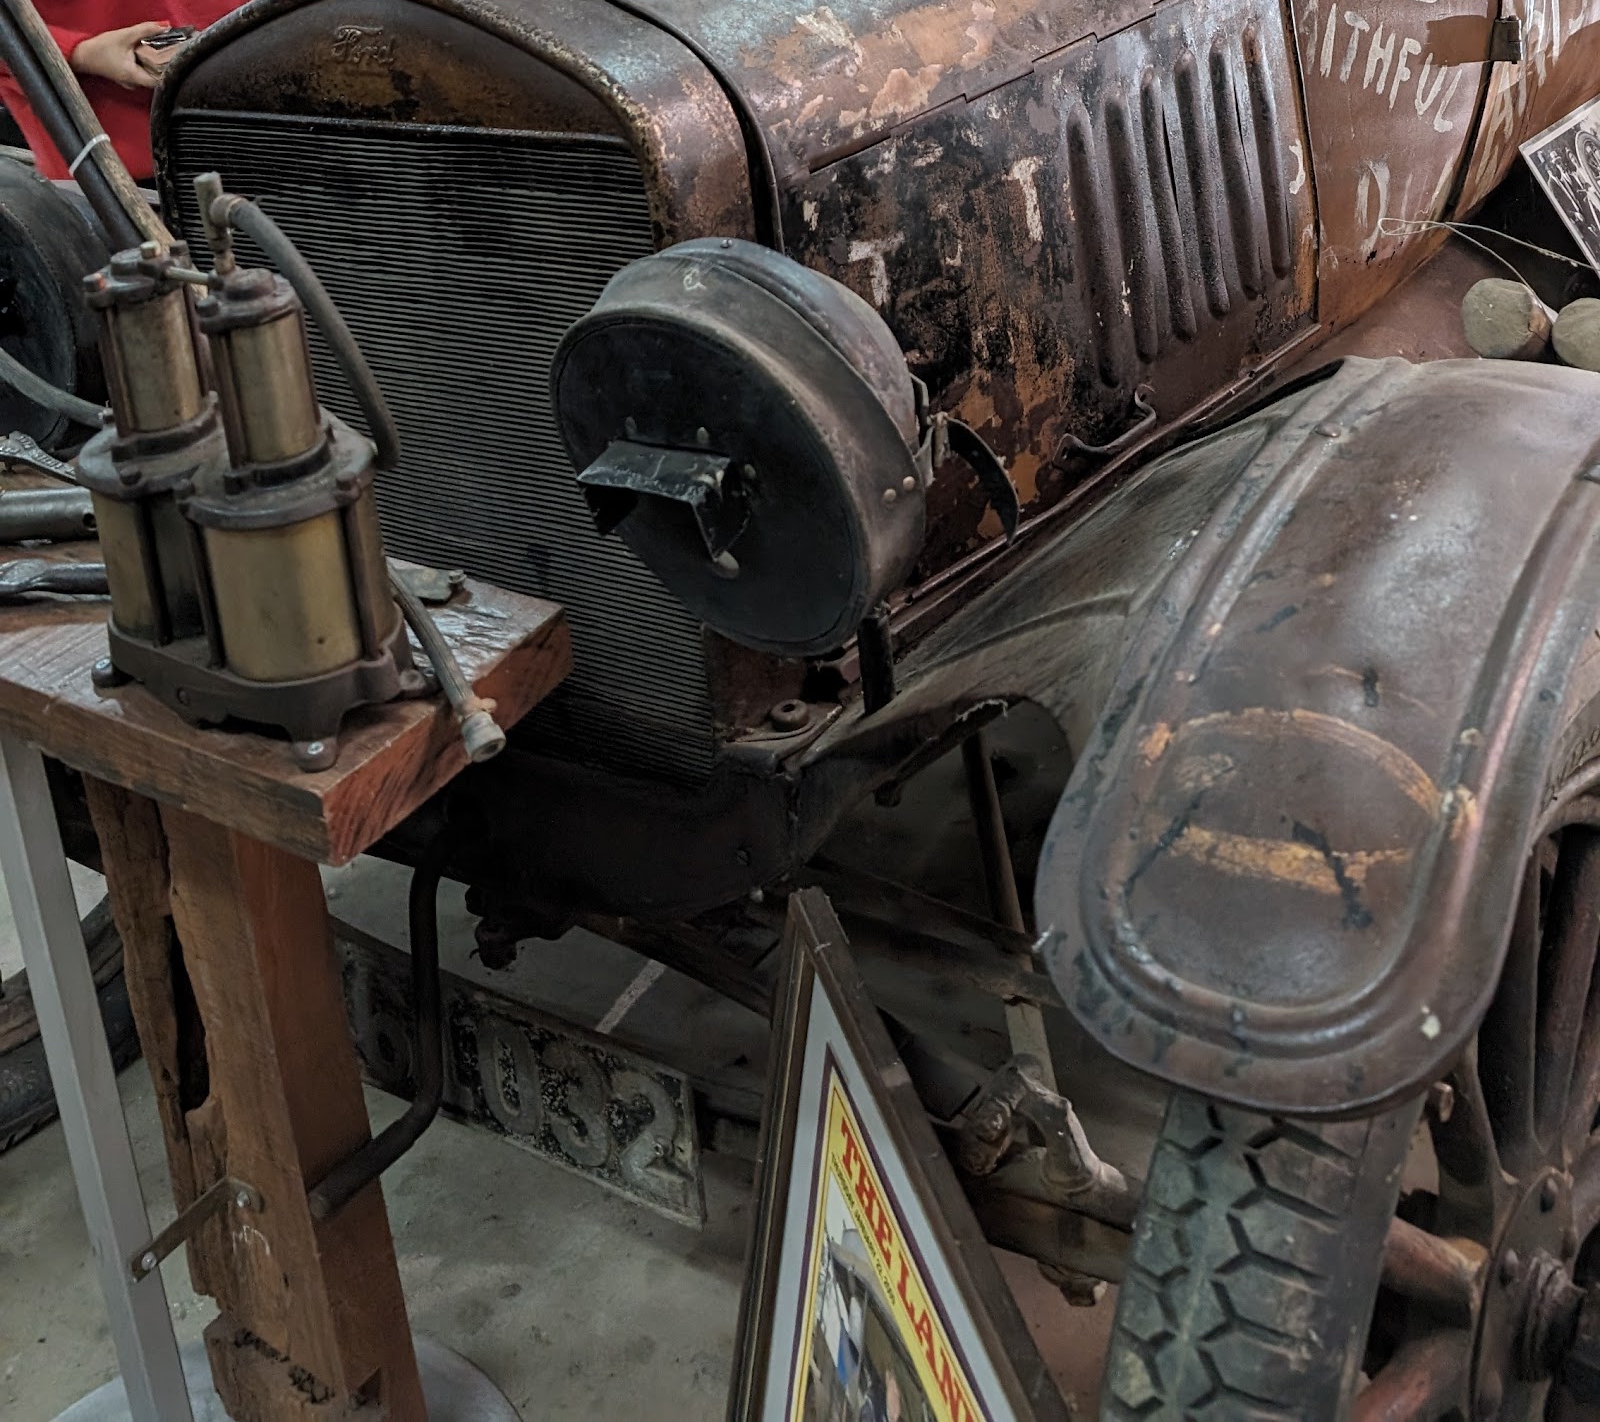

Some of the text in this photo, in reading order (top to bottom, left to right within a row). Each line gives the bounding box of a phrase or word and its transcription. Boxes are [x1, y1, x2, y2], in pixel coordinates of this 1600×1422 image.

[330, 24, 397, 65] Ford
[840, 1115, 894, 1270] THE
[897, 1246, 976, 1422] LAN
